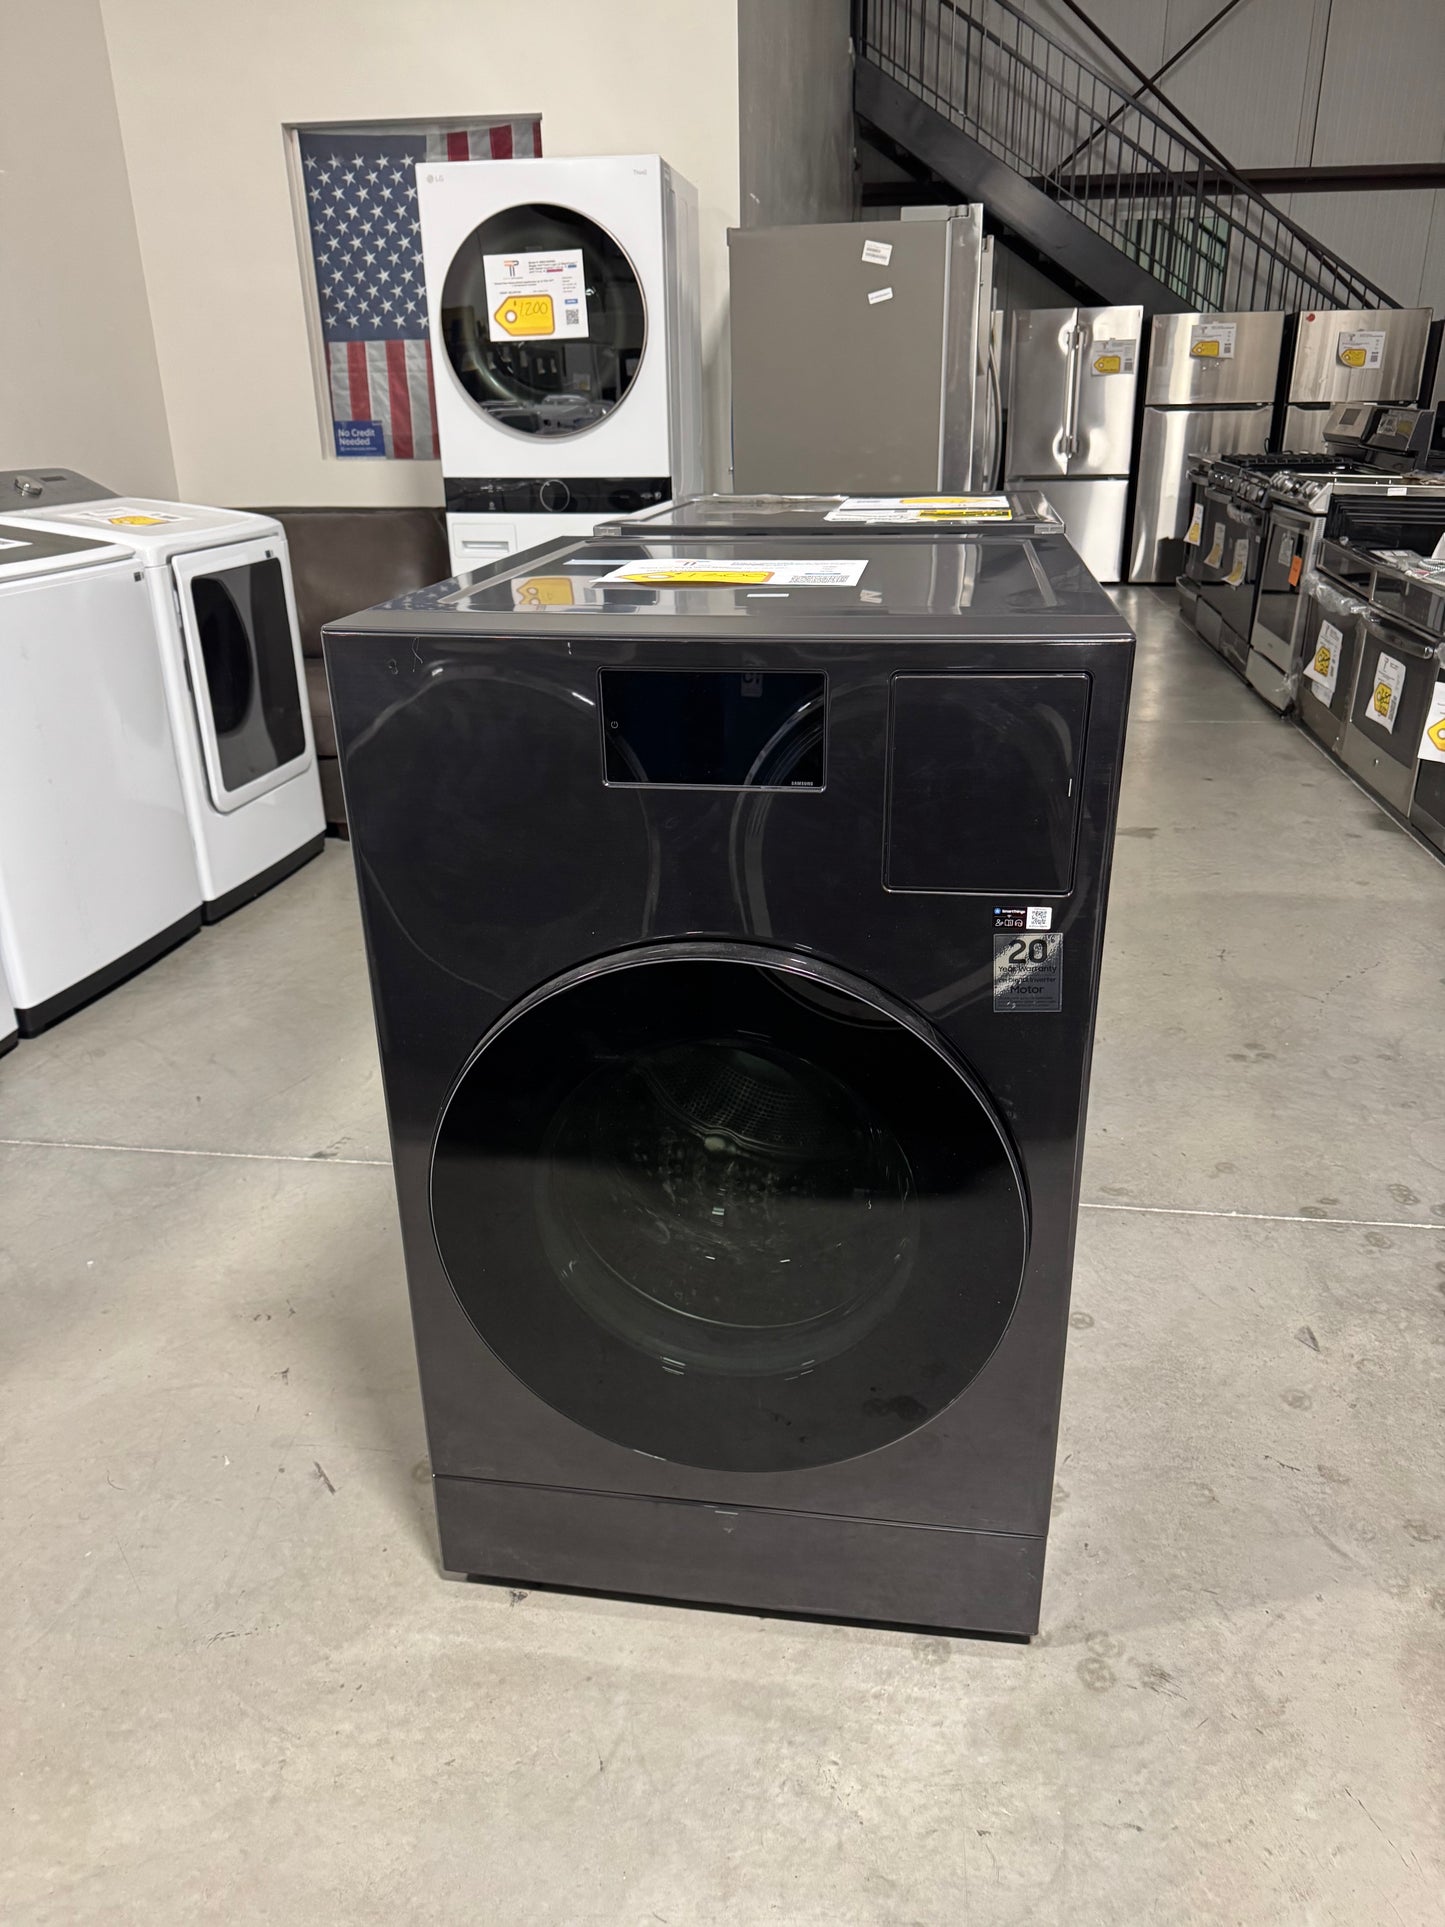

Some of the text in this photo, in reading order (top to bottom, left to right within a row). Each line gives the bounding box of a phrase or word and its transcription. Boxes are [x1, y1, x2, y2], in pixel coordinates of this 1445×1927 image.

[338, 429, 375, 437] No Credit
[1008, 938, 1048, 964] 20
[998, 965, 1057, 974] Year Warranty
[1010, 986, 1044, 994] Motor
